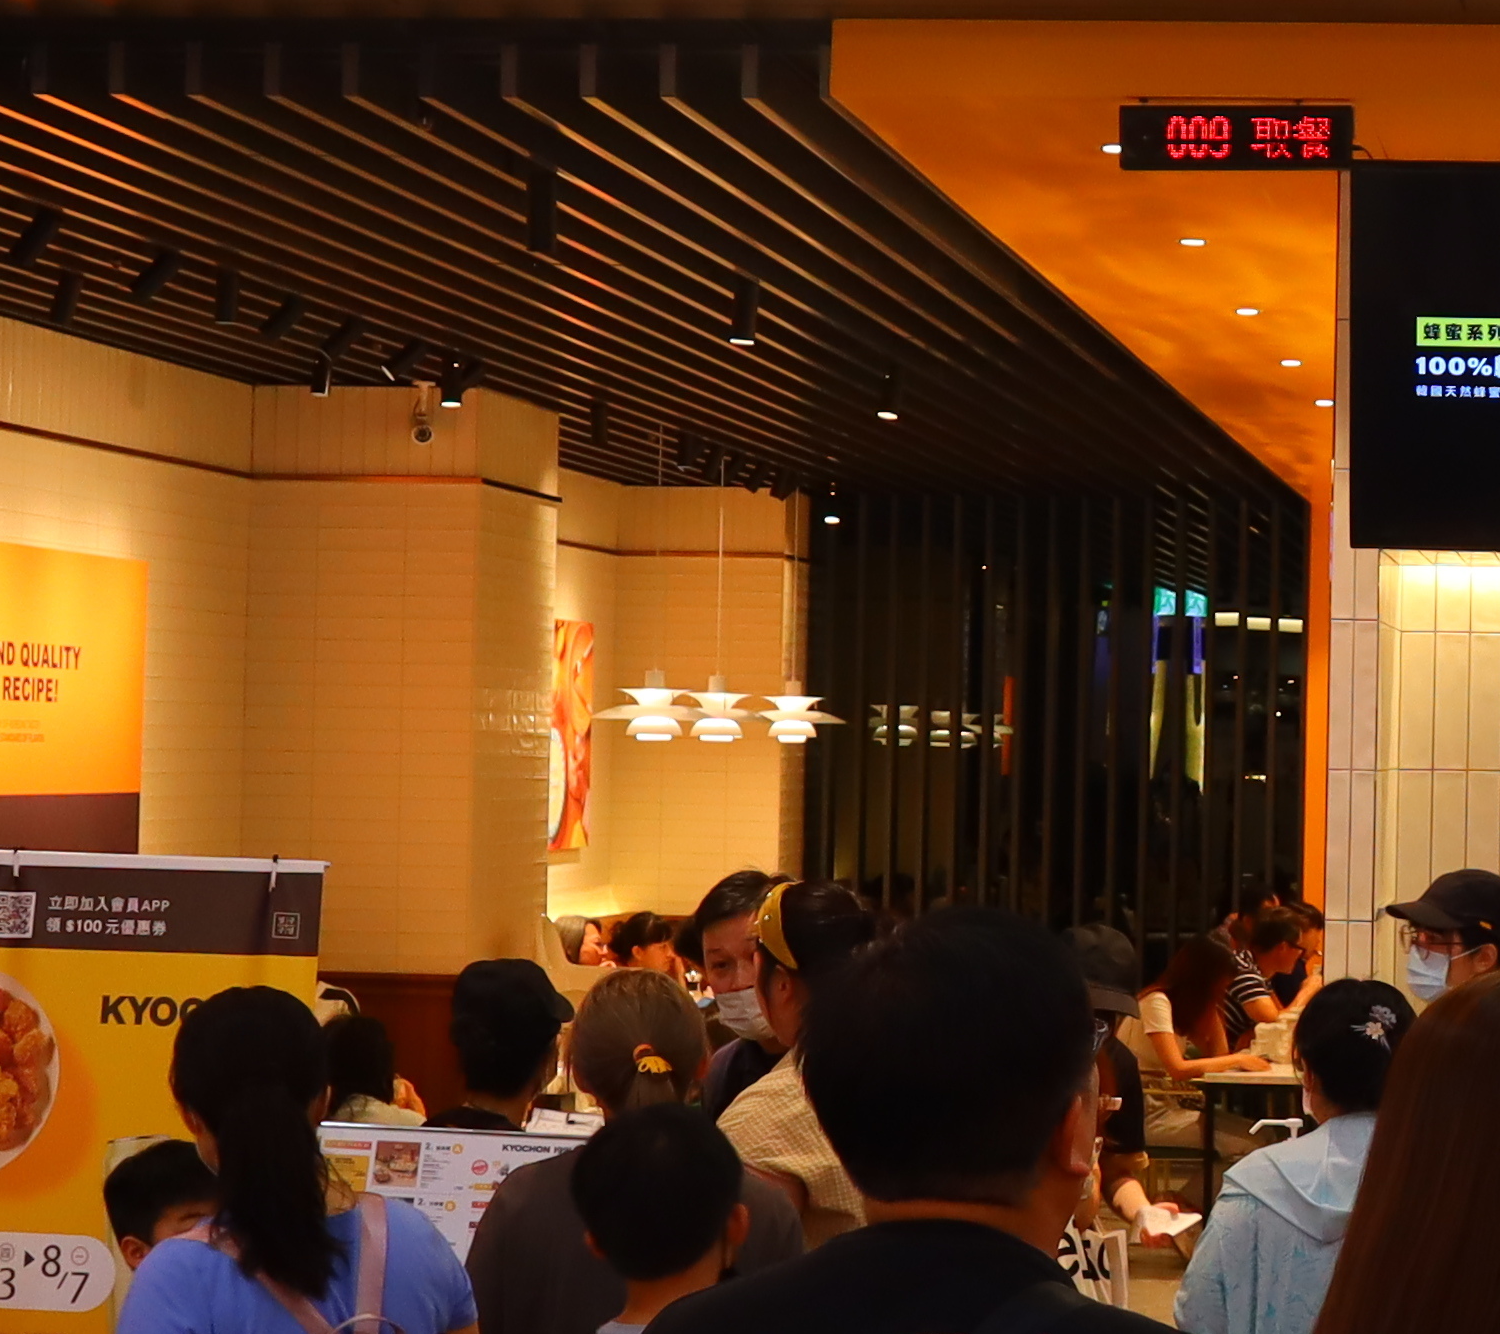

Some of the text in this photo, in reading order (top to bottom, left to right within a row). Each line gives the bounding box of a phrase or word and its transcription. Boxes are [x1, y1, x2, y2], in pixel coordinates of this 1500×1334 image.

[20, 642, 81, 670] QUALITY
[2, 675, 59, 703] RECIPE!
[47, 895, 171, 913] 立即加入會員APP
[65, 918, 103, 933] $100
[104, 918, 168, 936] 元優惠券
[99, 994, 205, 1026] KYOC
